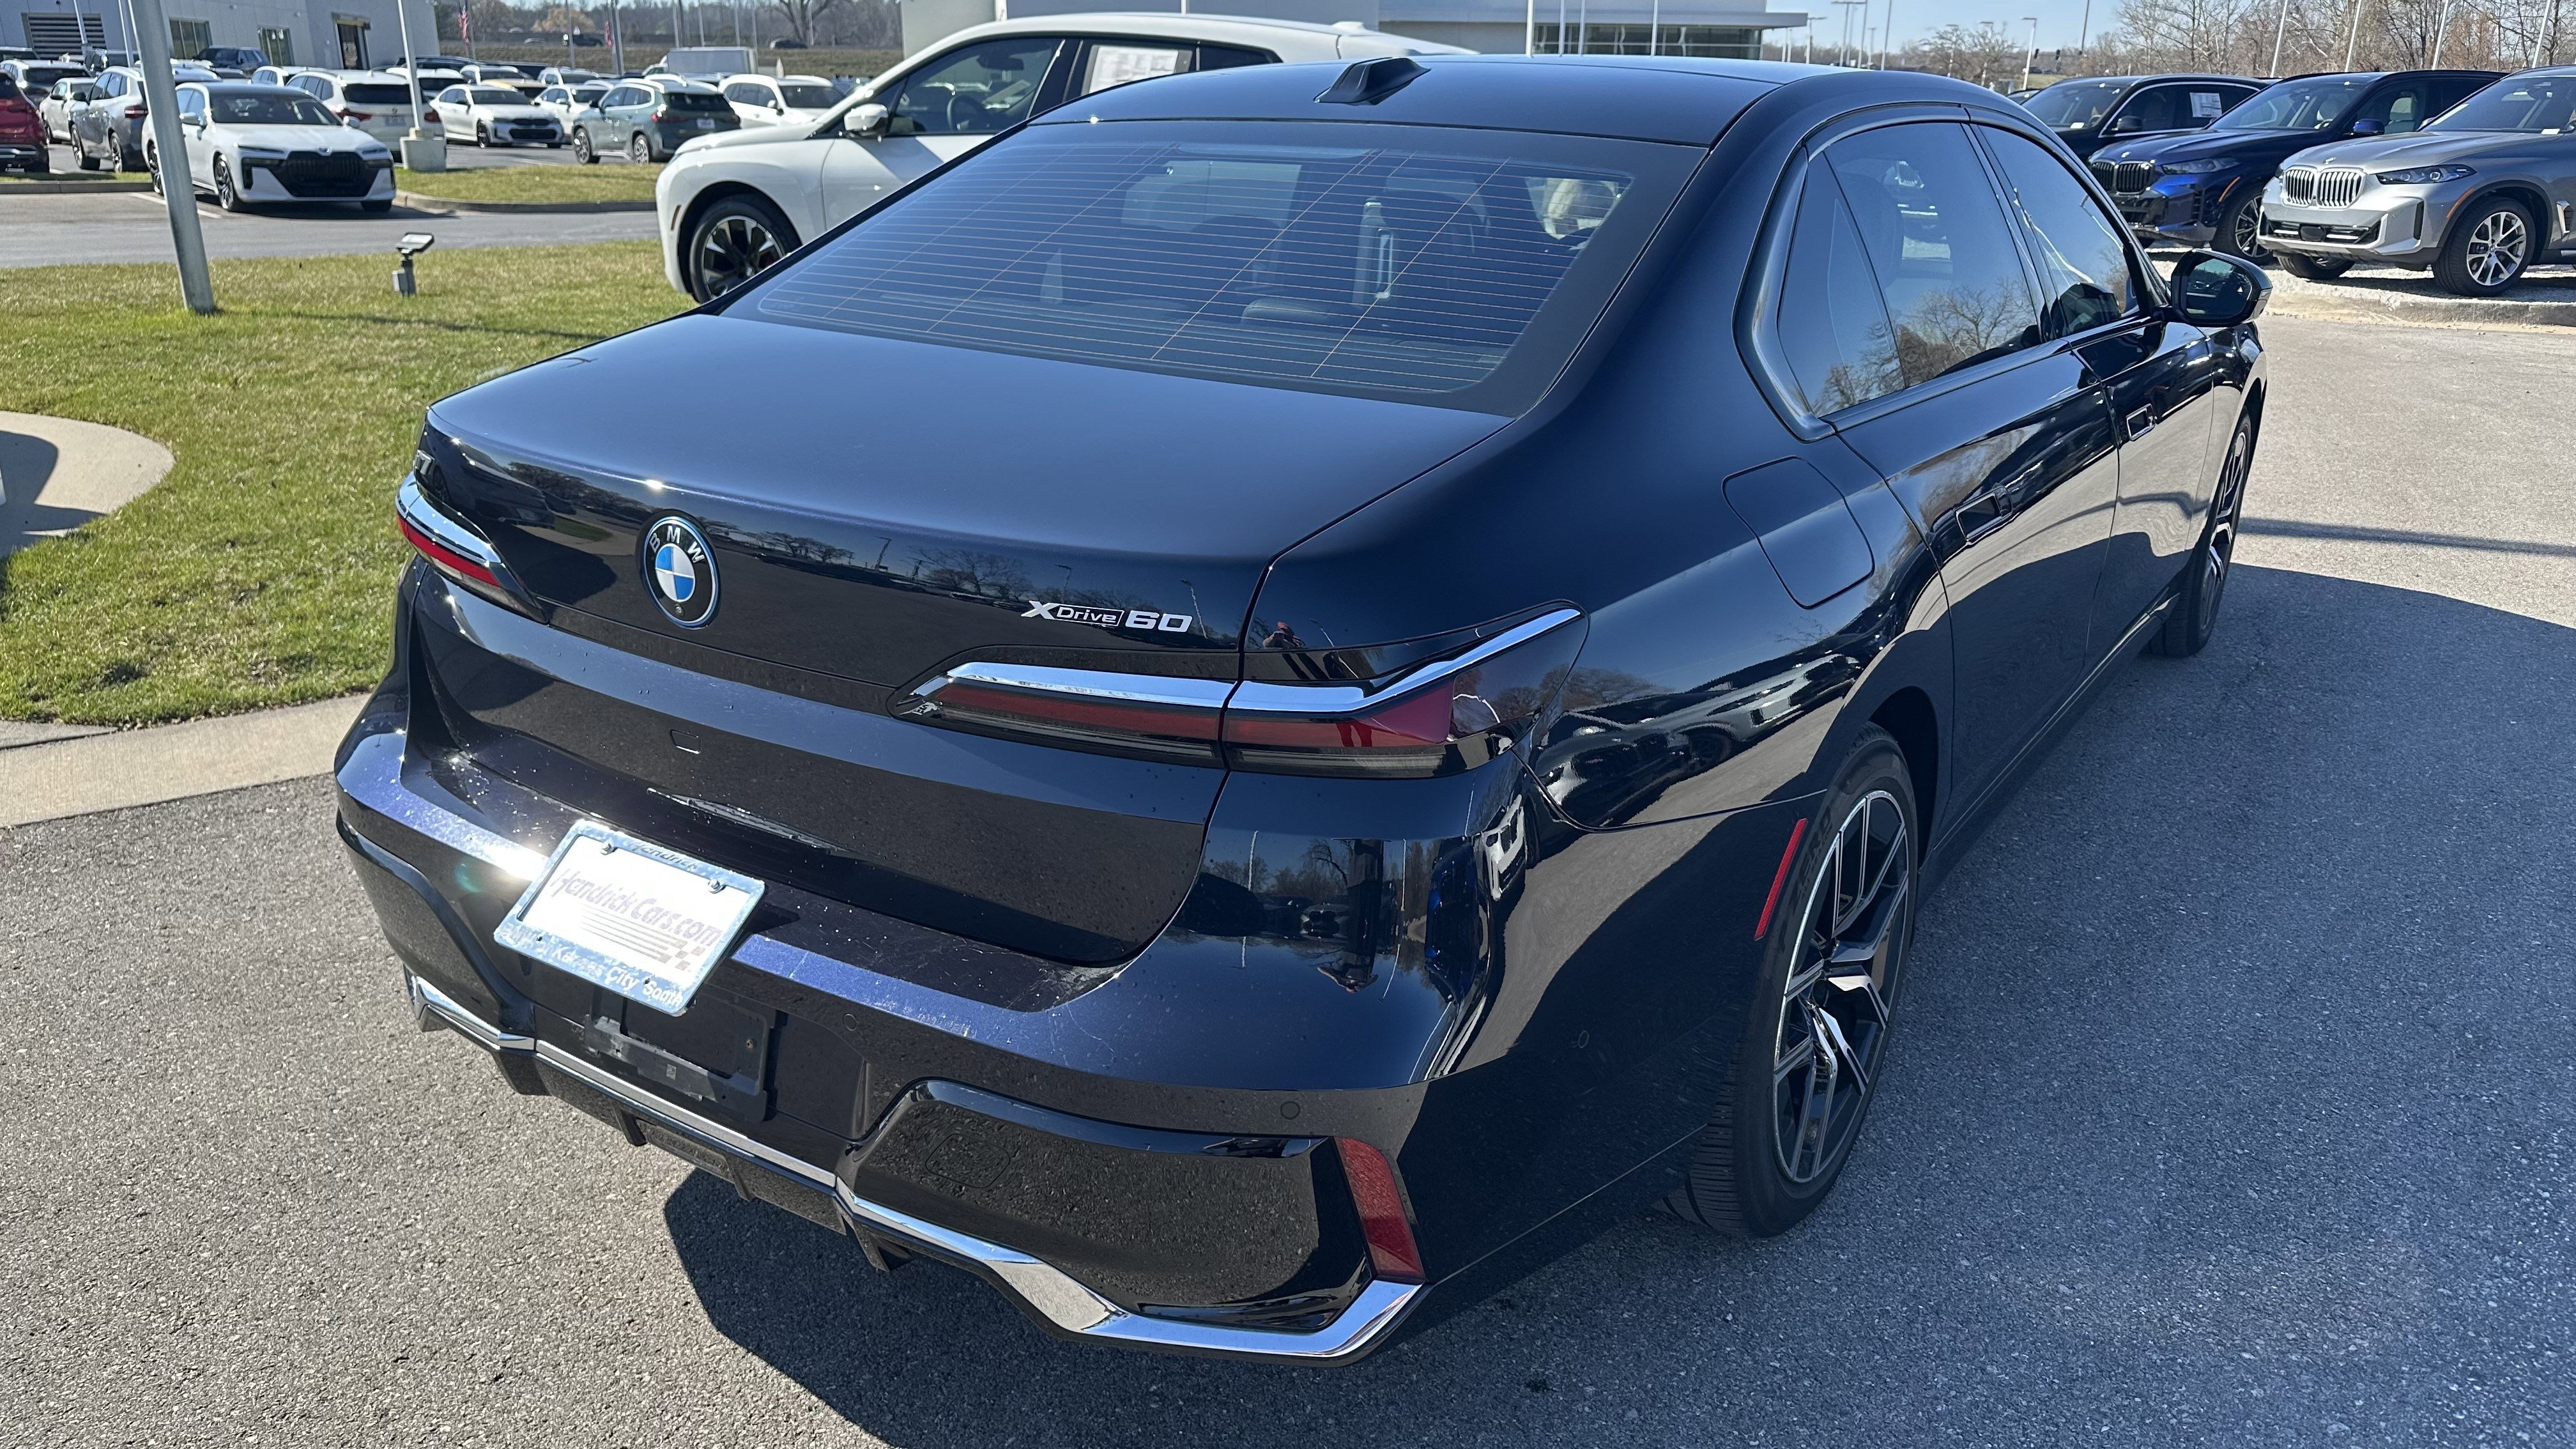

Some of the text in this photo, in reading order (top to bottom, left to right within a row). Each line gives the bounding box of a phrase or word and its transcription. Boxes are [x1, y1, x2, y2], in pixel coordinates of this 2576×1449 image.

[649, 525, 705, 564] BMW
[628, 843, 700, 870] Hendrick
[604, 965, 640, 991] City
[642, 978, 684, 1008] South
